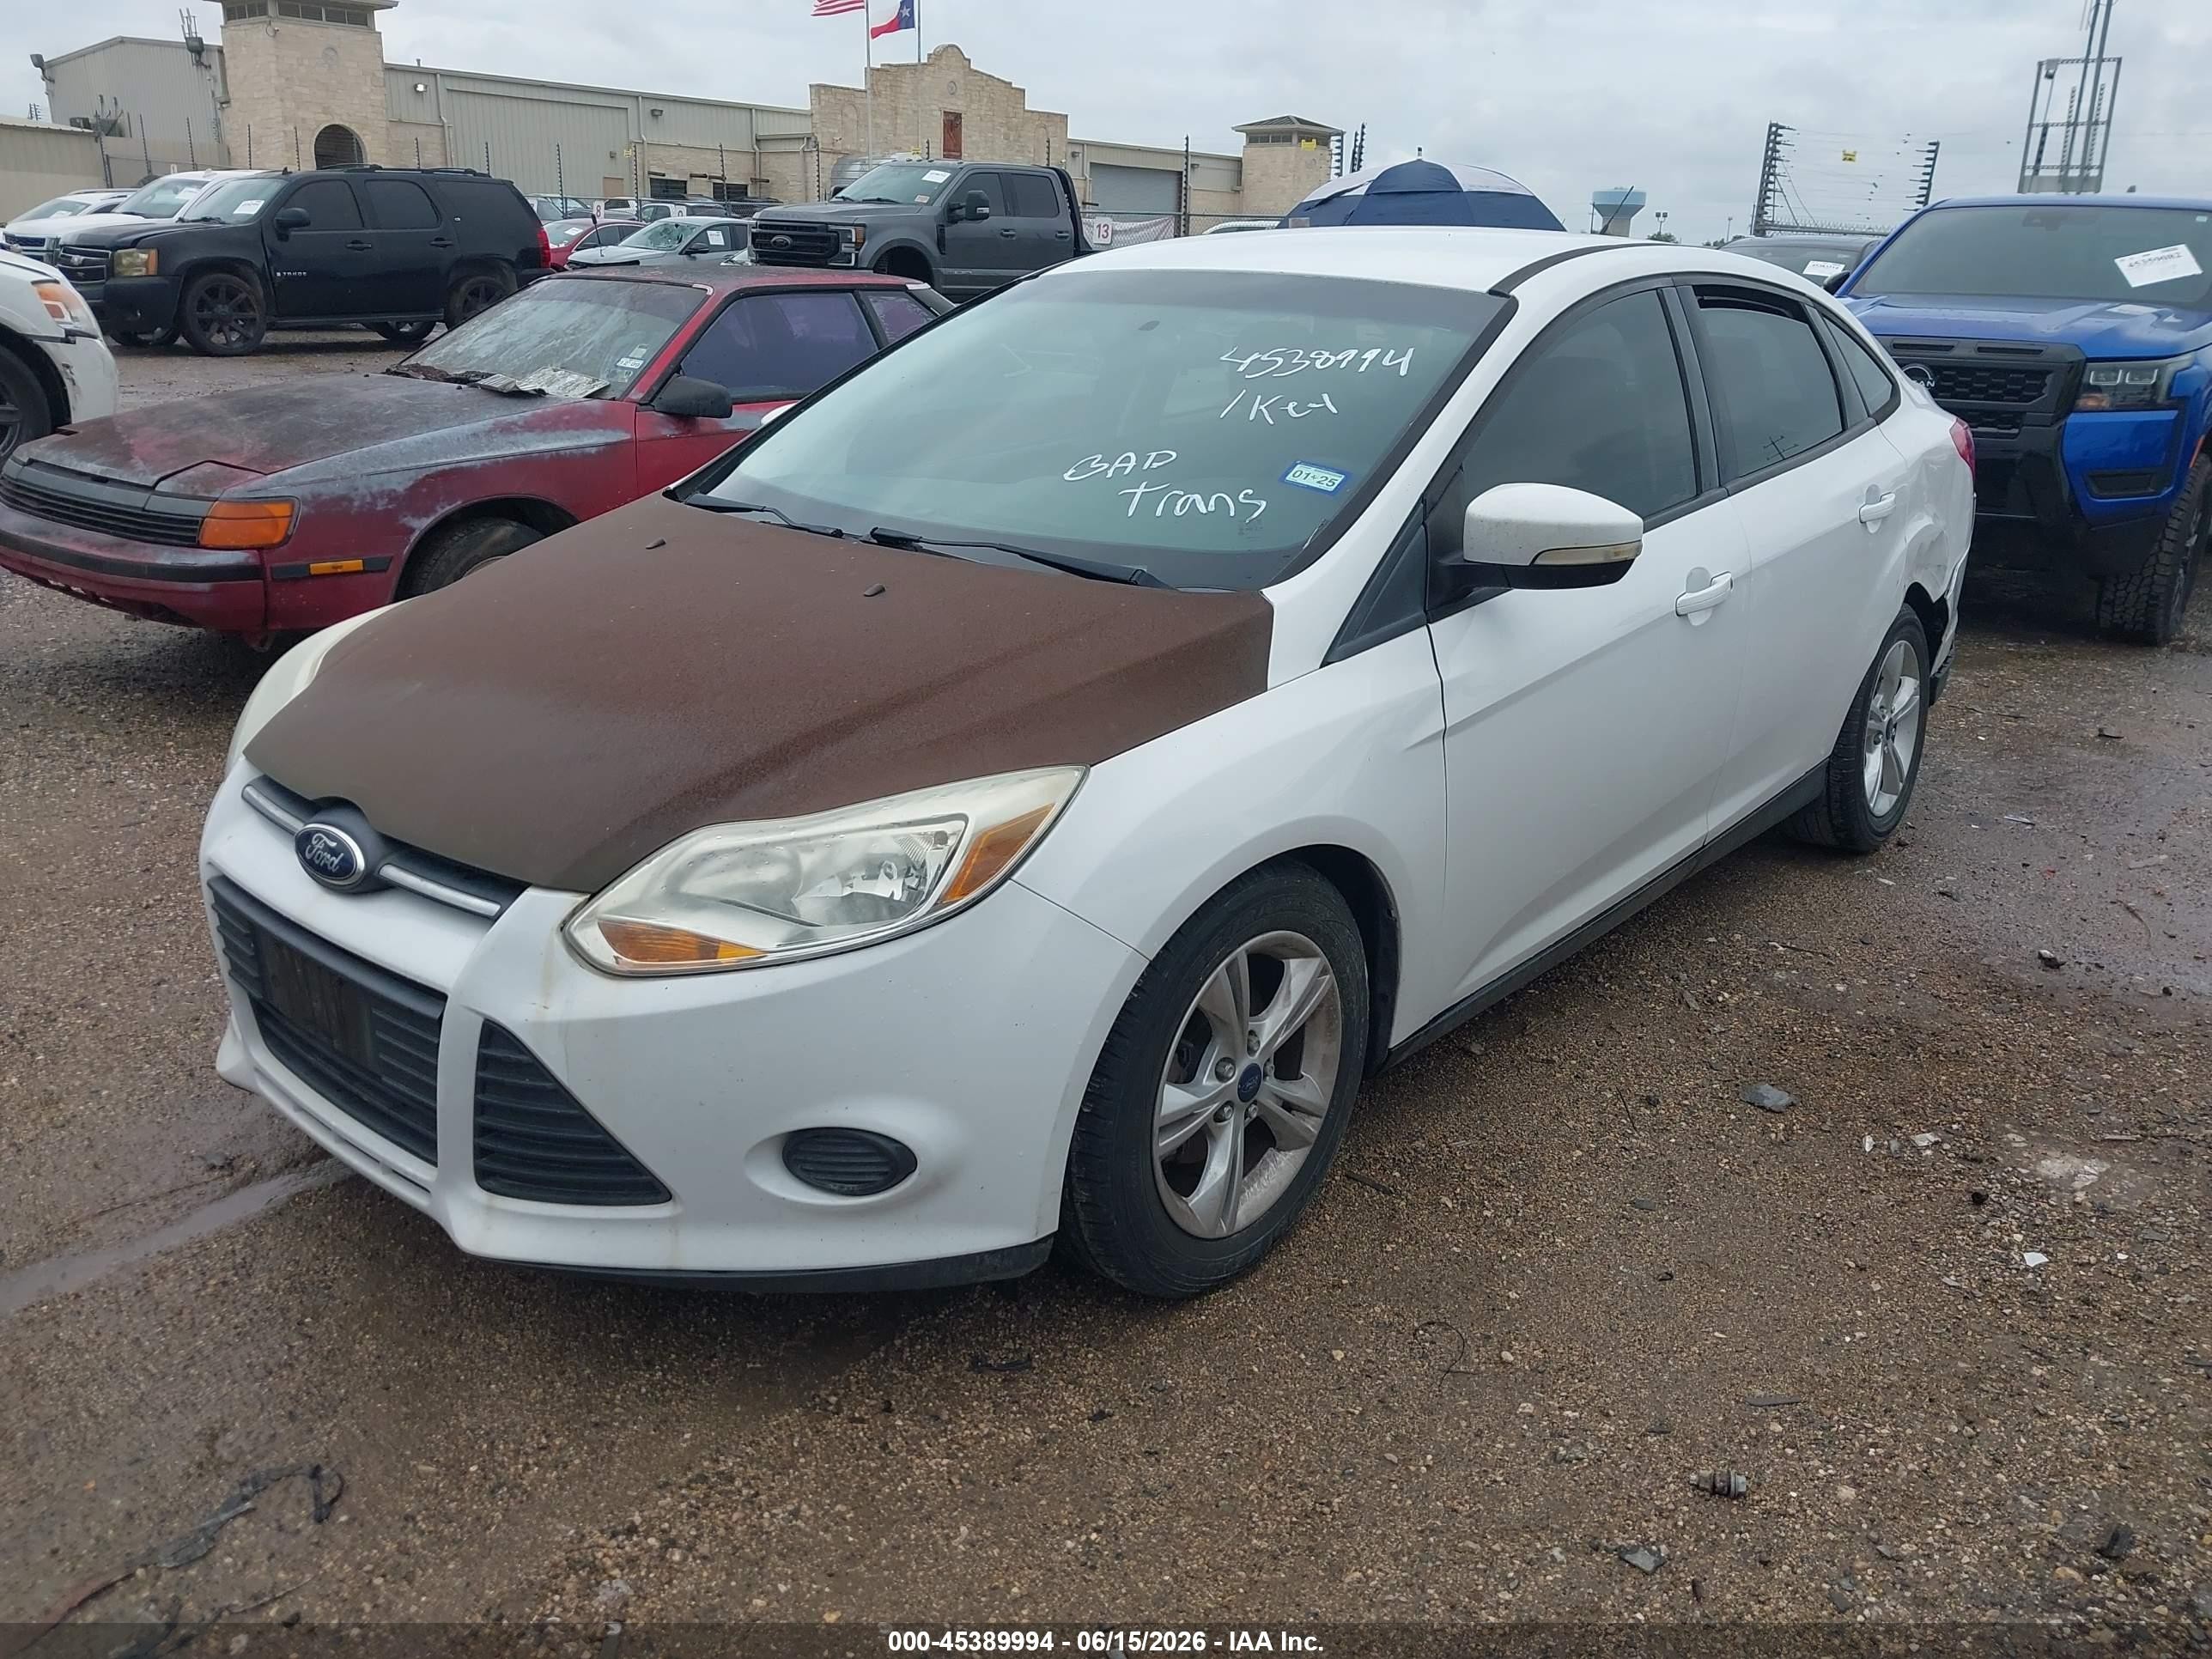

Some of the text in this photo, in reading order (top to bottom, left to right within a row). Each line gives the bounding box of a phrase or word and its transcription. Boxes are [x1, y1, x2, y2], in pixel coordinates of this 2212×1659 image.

[596, 204, 602, 218] 8
[1096, 223, 1110, 239] 13
[1063, 450, 1178, 482] BAD
[305, 832, 344, 873] Ford
